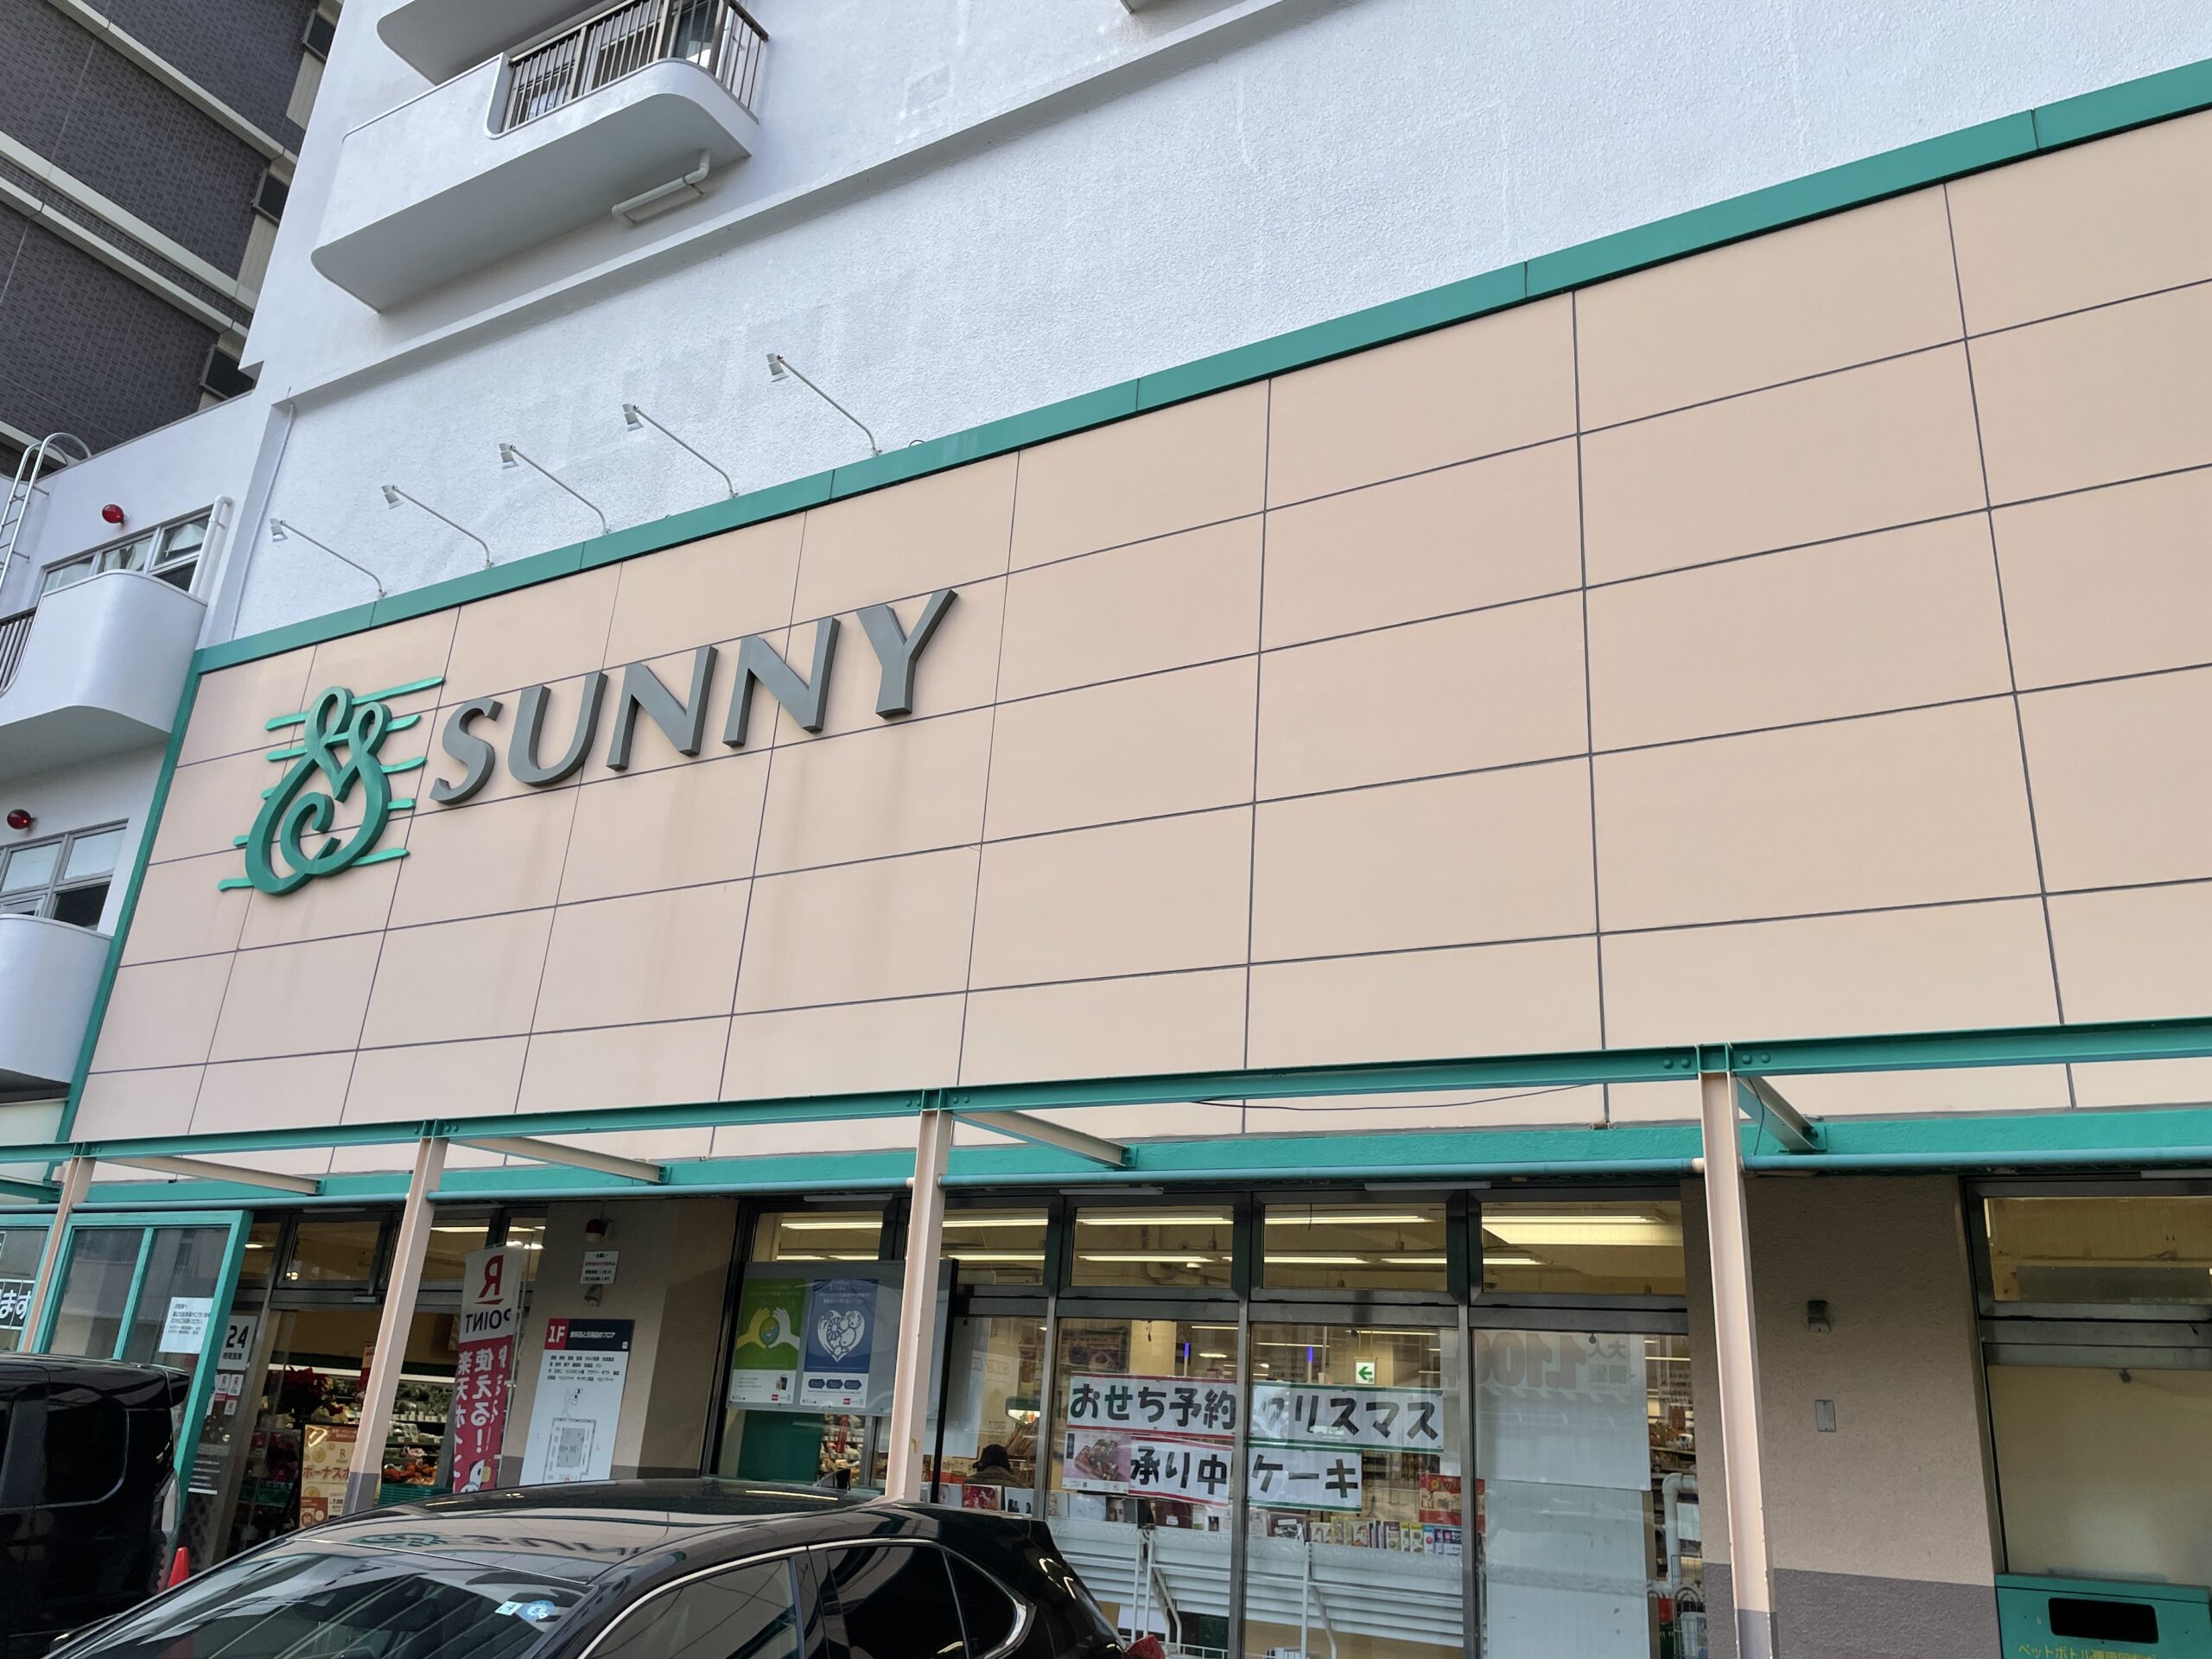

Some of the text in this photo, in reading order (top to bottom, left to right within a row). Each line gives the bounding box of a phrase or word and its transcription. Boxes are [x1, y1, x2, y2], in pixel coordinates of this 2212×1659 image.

[429, 588, 959, 807] SUNNY
[0, 1289, 32, 1320] ます
[226, 1325, 250, 1349] 24
[548, 1325, 566, 1343] 1F
[1070, 1383, 1236, 1430] おせち予約
[1130, 1446, 1228, 1496] 承り中
[1251, 1453, 1359, 1499] ケーキ
